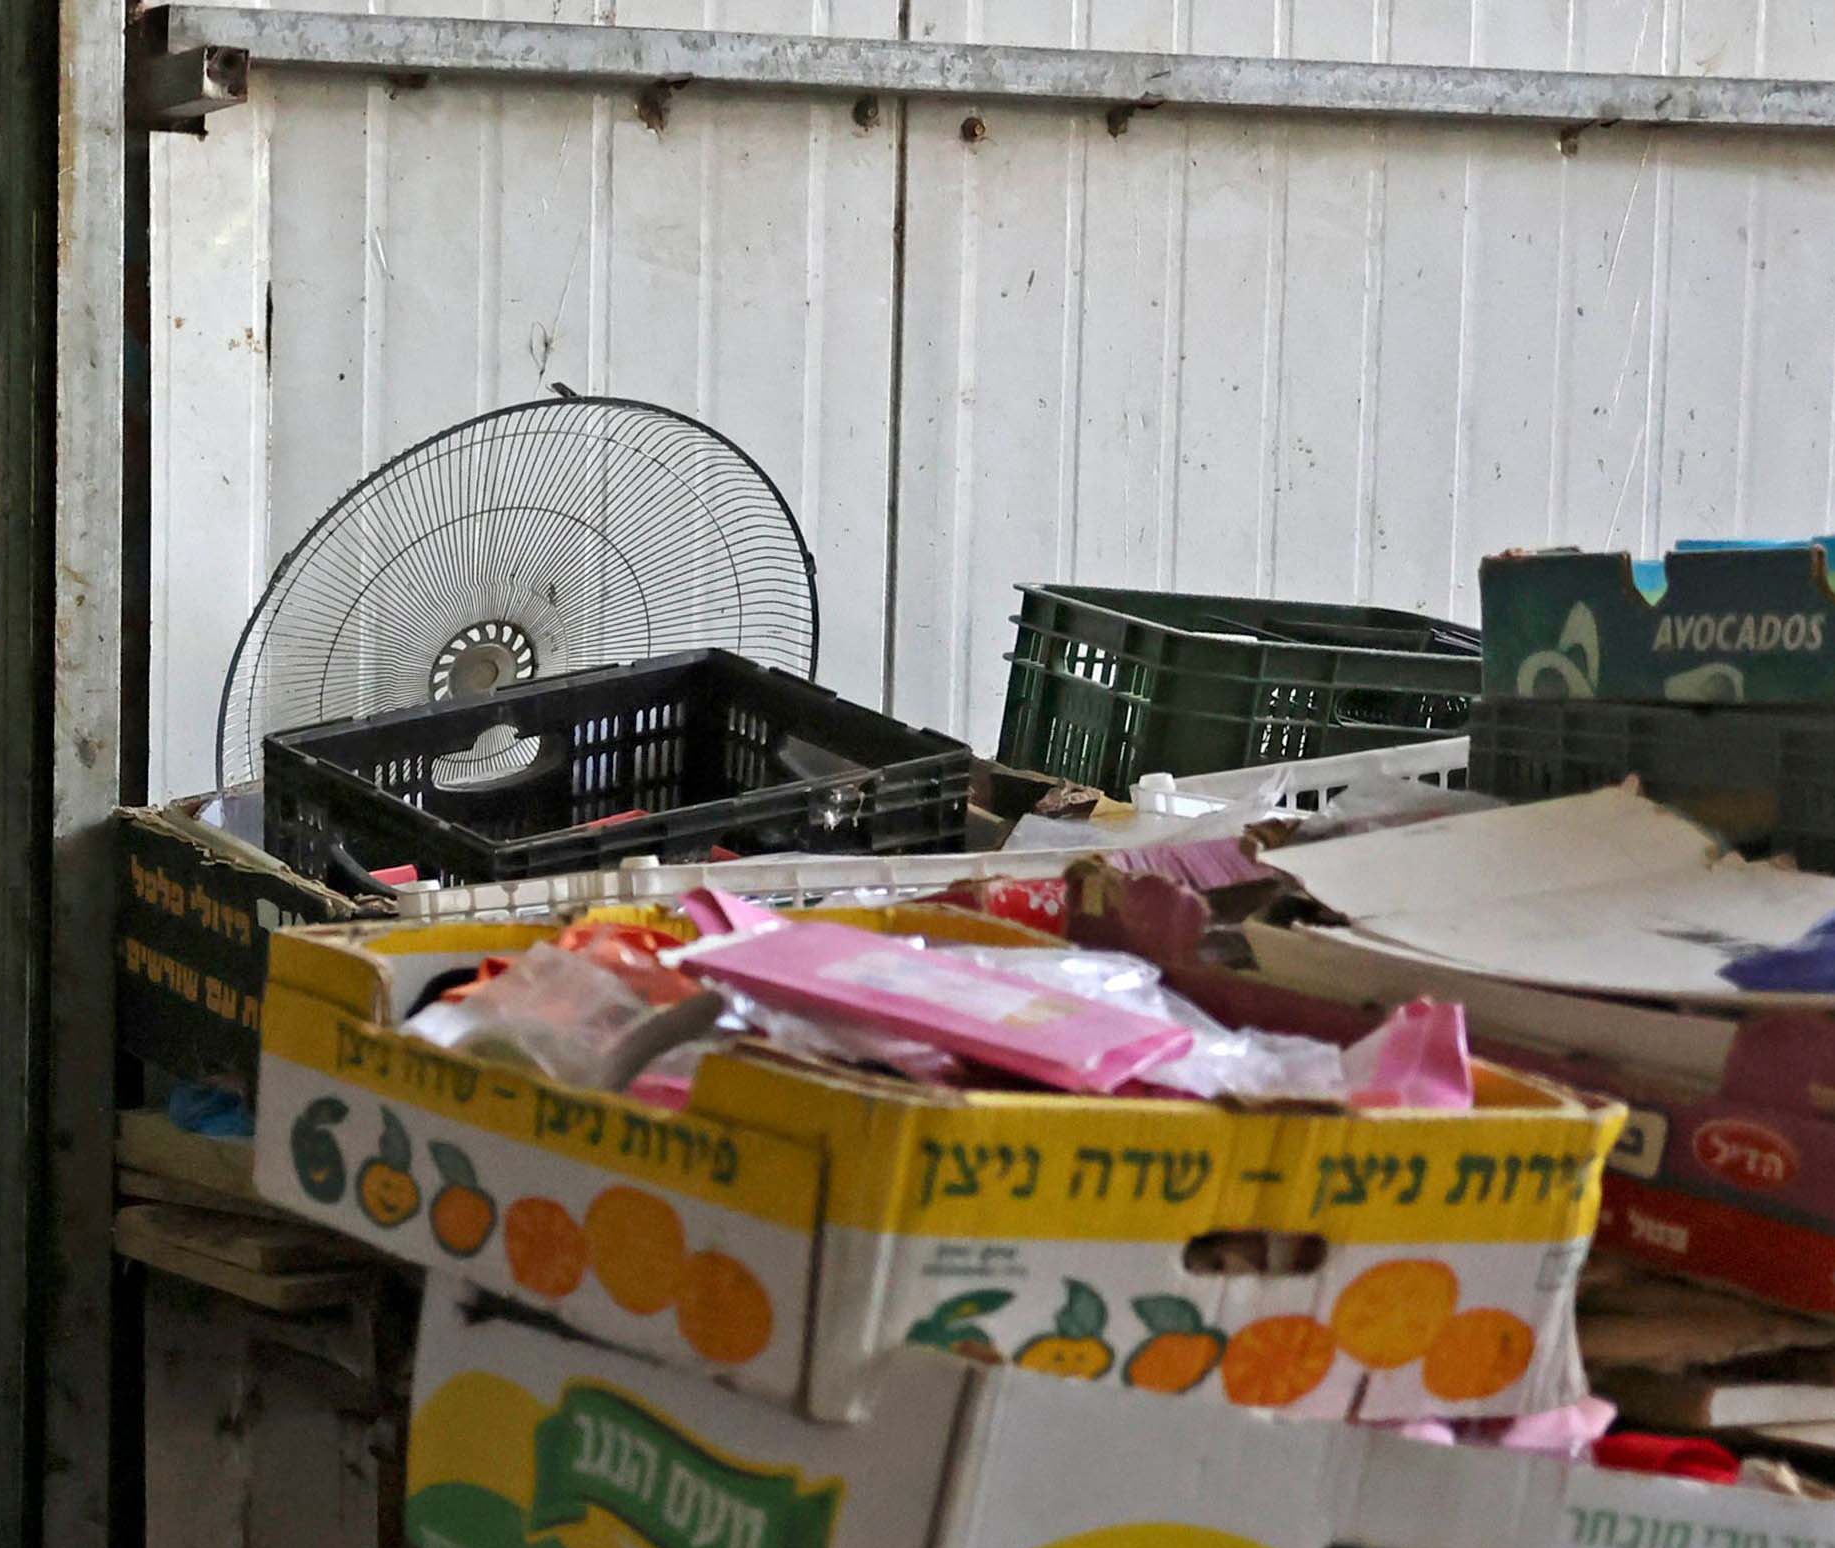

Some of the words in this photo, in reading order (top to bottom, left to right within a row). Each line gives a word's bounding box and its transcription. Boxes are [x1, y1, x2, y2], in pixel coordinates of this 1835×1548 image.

[1652, 613, 1826, 652] AVOCADOS
[404, 1044, 482, 1104] שדה
[533, 1085, 607, 1147] ניצן
[620, 1110, 740, 1186] פירות
[917, 1136, 1041, 1205] ניצן
[1069, 1145, 1212, 1206] שדה
[1308, 1149, 1429, 1217] ניצן
[571, 1412, 663, 1501] הנגב
